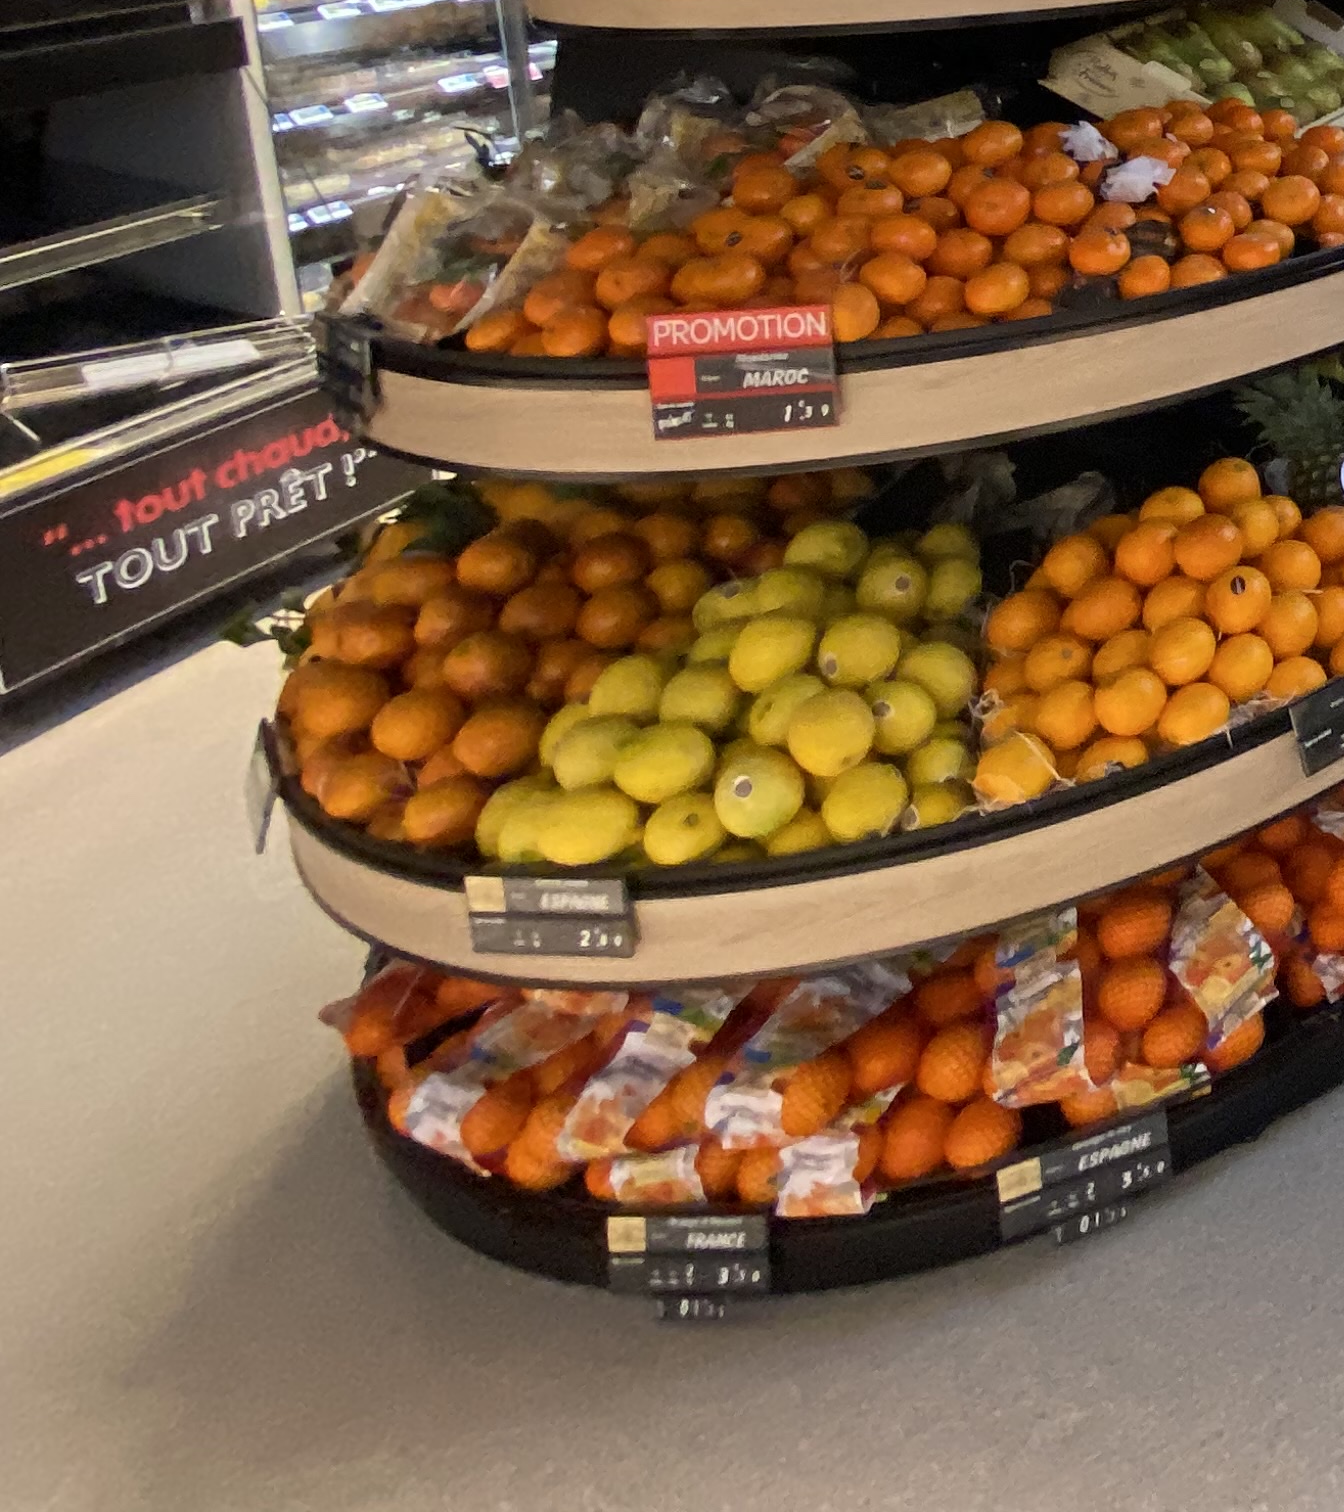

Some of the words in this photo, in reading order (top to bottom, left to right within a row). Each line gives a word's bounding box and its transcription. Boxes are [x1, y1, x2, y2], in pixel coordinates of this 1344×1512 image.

[653, 311, 827, 347] PROMOTION
[742, 367, 810, 389] MAROC
[113, 466, 208, 534] tout
[75, 513, 219, 605] TOUT
[230, 462, 333, 540] PRÊT
[1077, 1131, 1152, 1172] ESPAGNE
